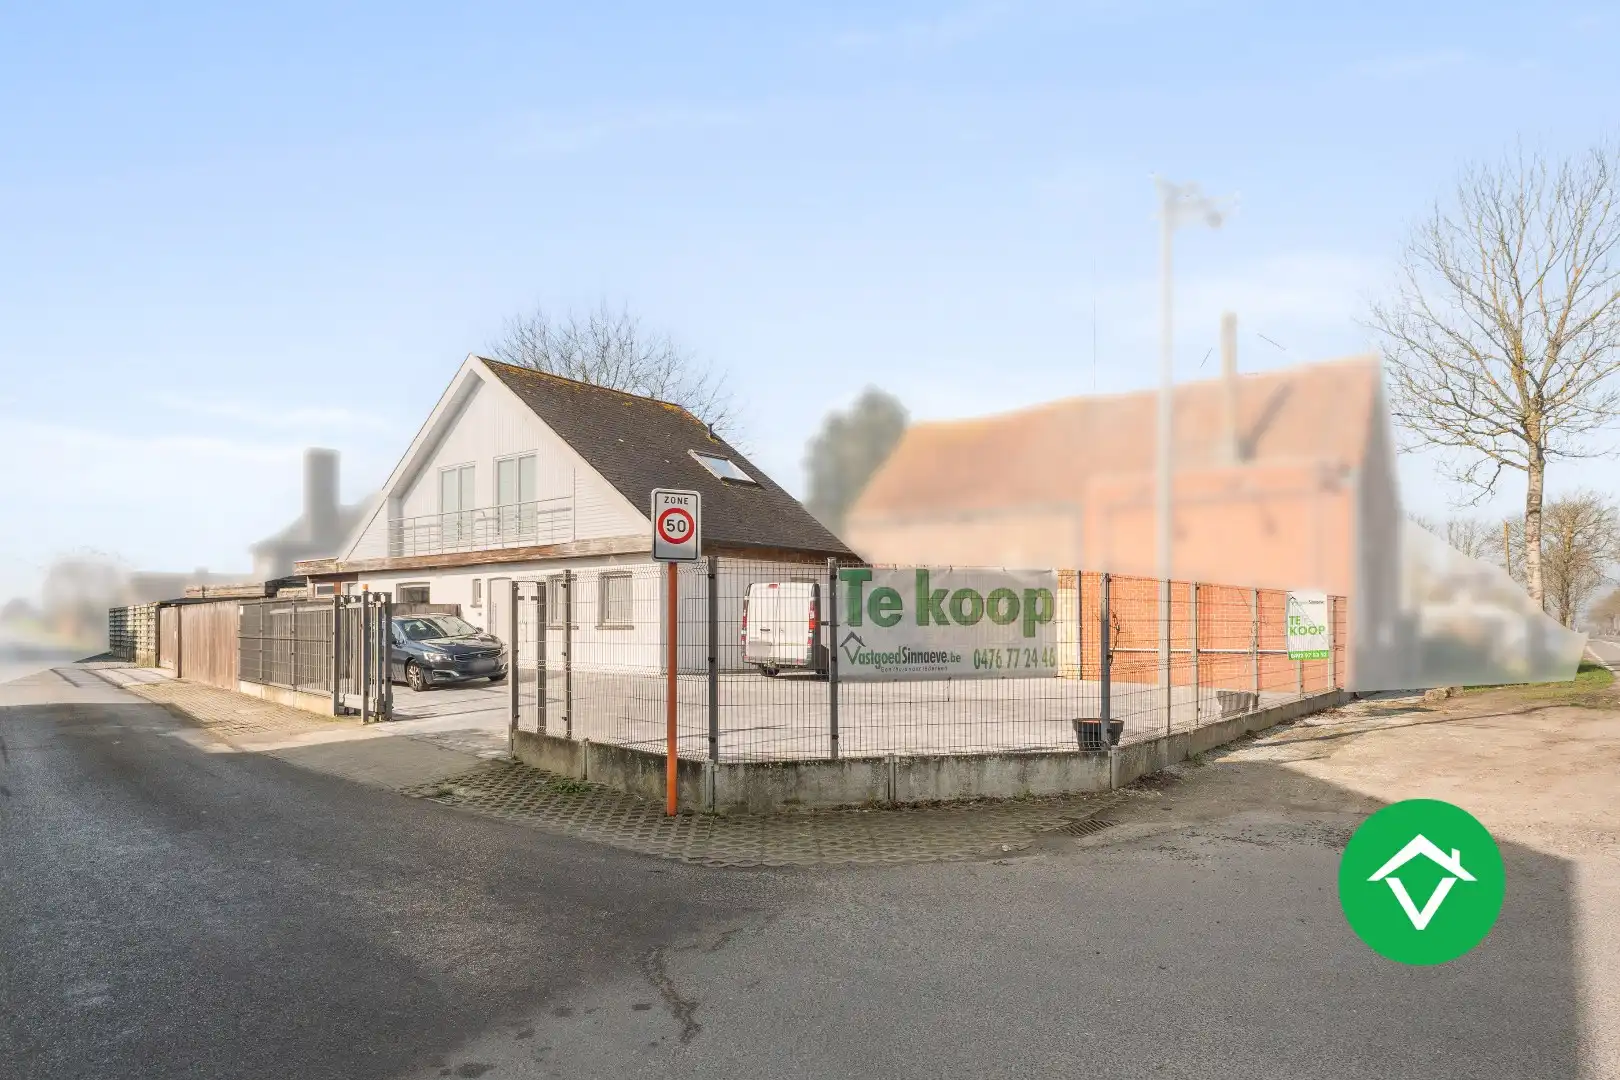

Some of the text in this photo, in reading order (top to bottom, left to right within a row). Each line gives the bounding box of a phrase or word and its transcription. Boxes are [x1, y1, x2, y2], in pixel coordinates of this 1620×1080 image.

[664, 496, 689, 505] ZONE
[666, 519, 686, 533] 50
[838, 568, 1055, 638] Te koop
[1289, 615, 1301, 625] TE
[1289, 625, 1325, 636] KOOP
[973, 646, 1056, 669] 0476 77 24 46
